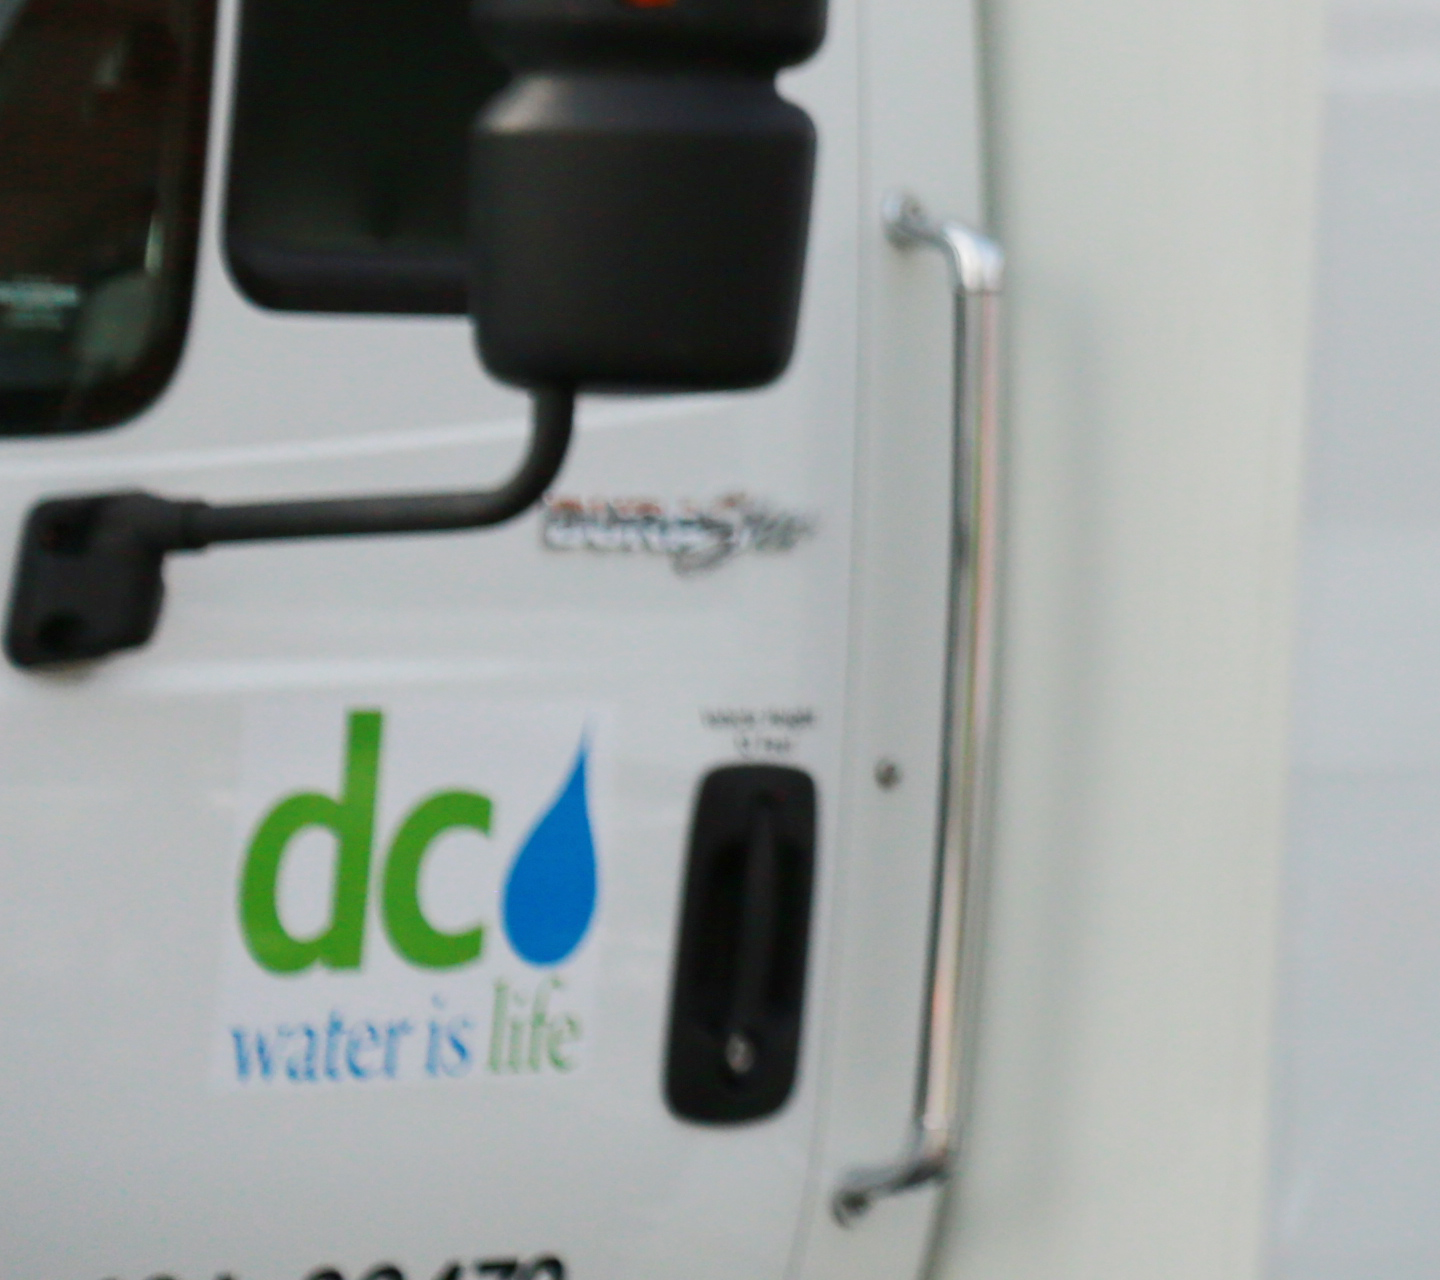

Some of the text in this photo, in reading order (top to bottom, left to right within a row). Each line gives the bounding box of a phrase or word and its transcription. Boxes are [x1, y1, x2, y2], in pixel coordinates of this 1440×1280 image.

[238, 709, 494, 974] dc
[230, 973, 583, 1084] water is life
